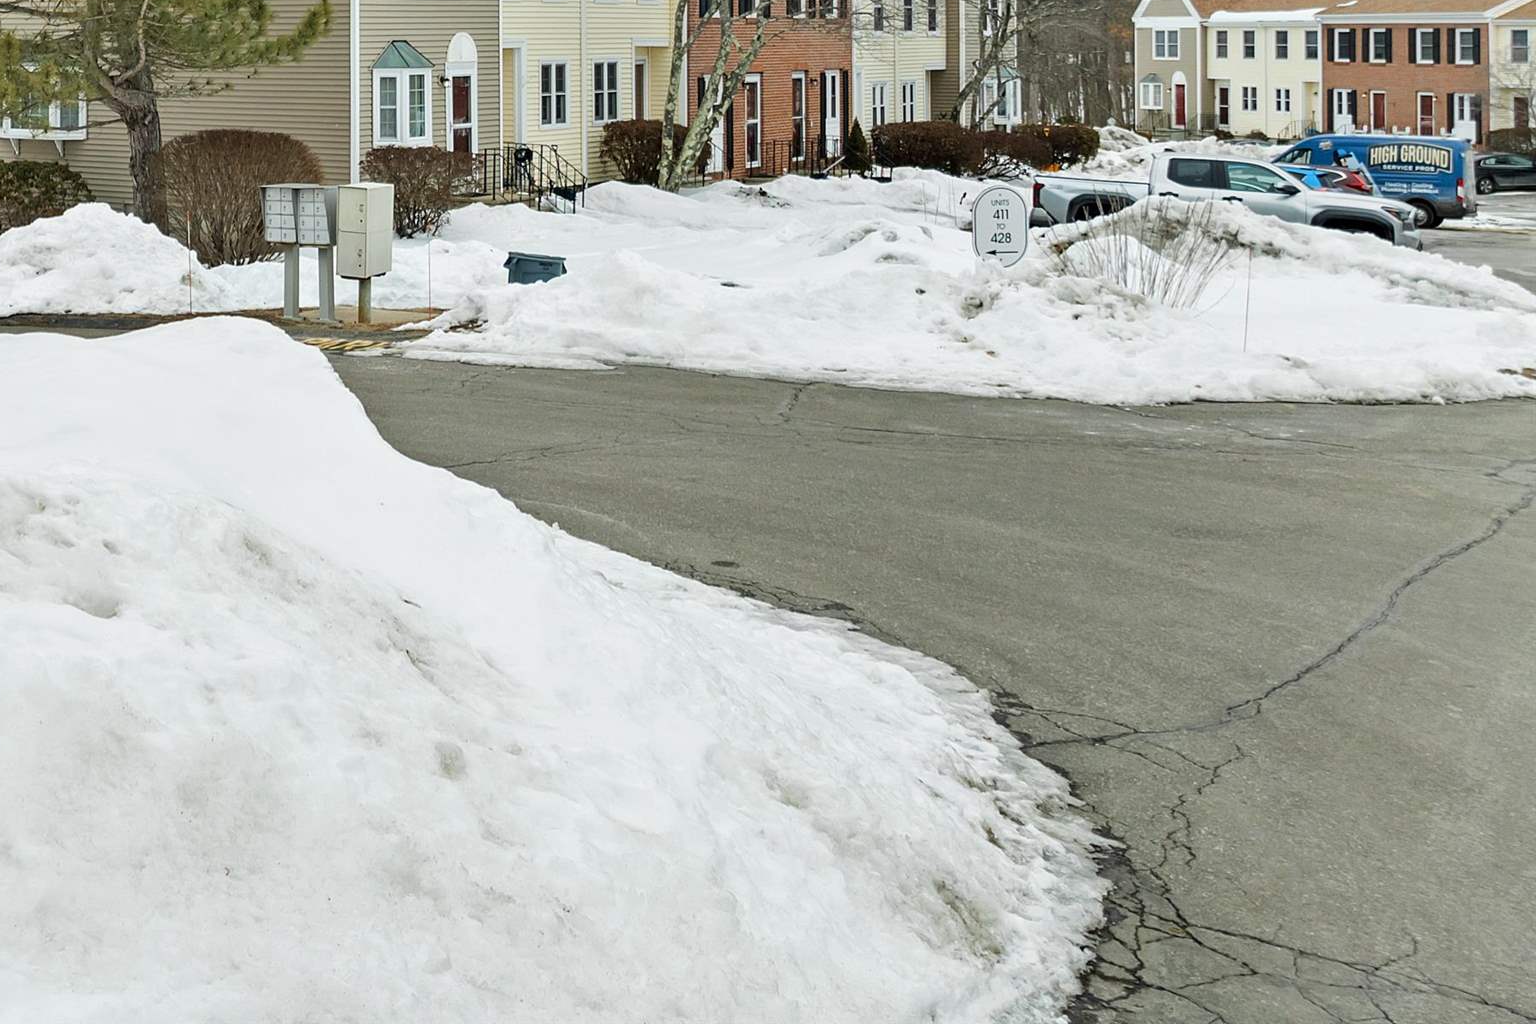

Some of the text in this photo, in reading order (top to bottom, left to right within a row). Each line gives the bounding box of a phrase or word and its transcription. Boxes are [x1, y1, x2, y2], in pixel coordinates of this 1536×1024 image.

[1370, 144, 1448, 168] HIGH GROUND
[993, 209, 1009, 220] 411
[991, 233, 1011, 243] 428
